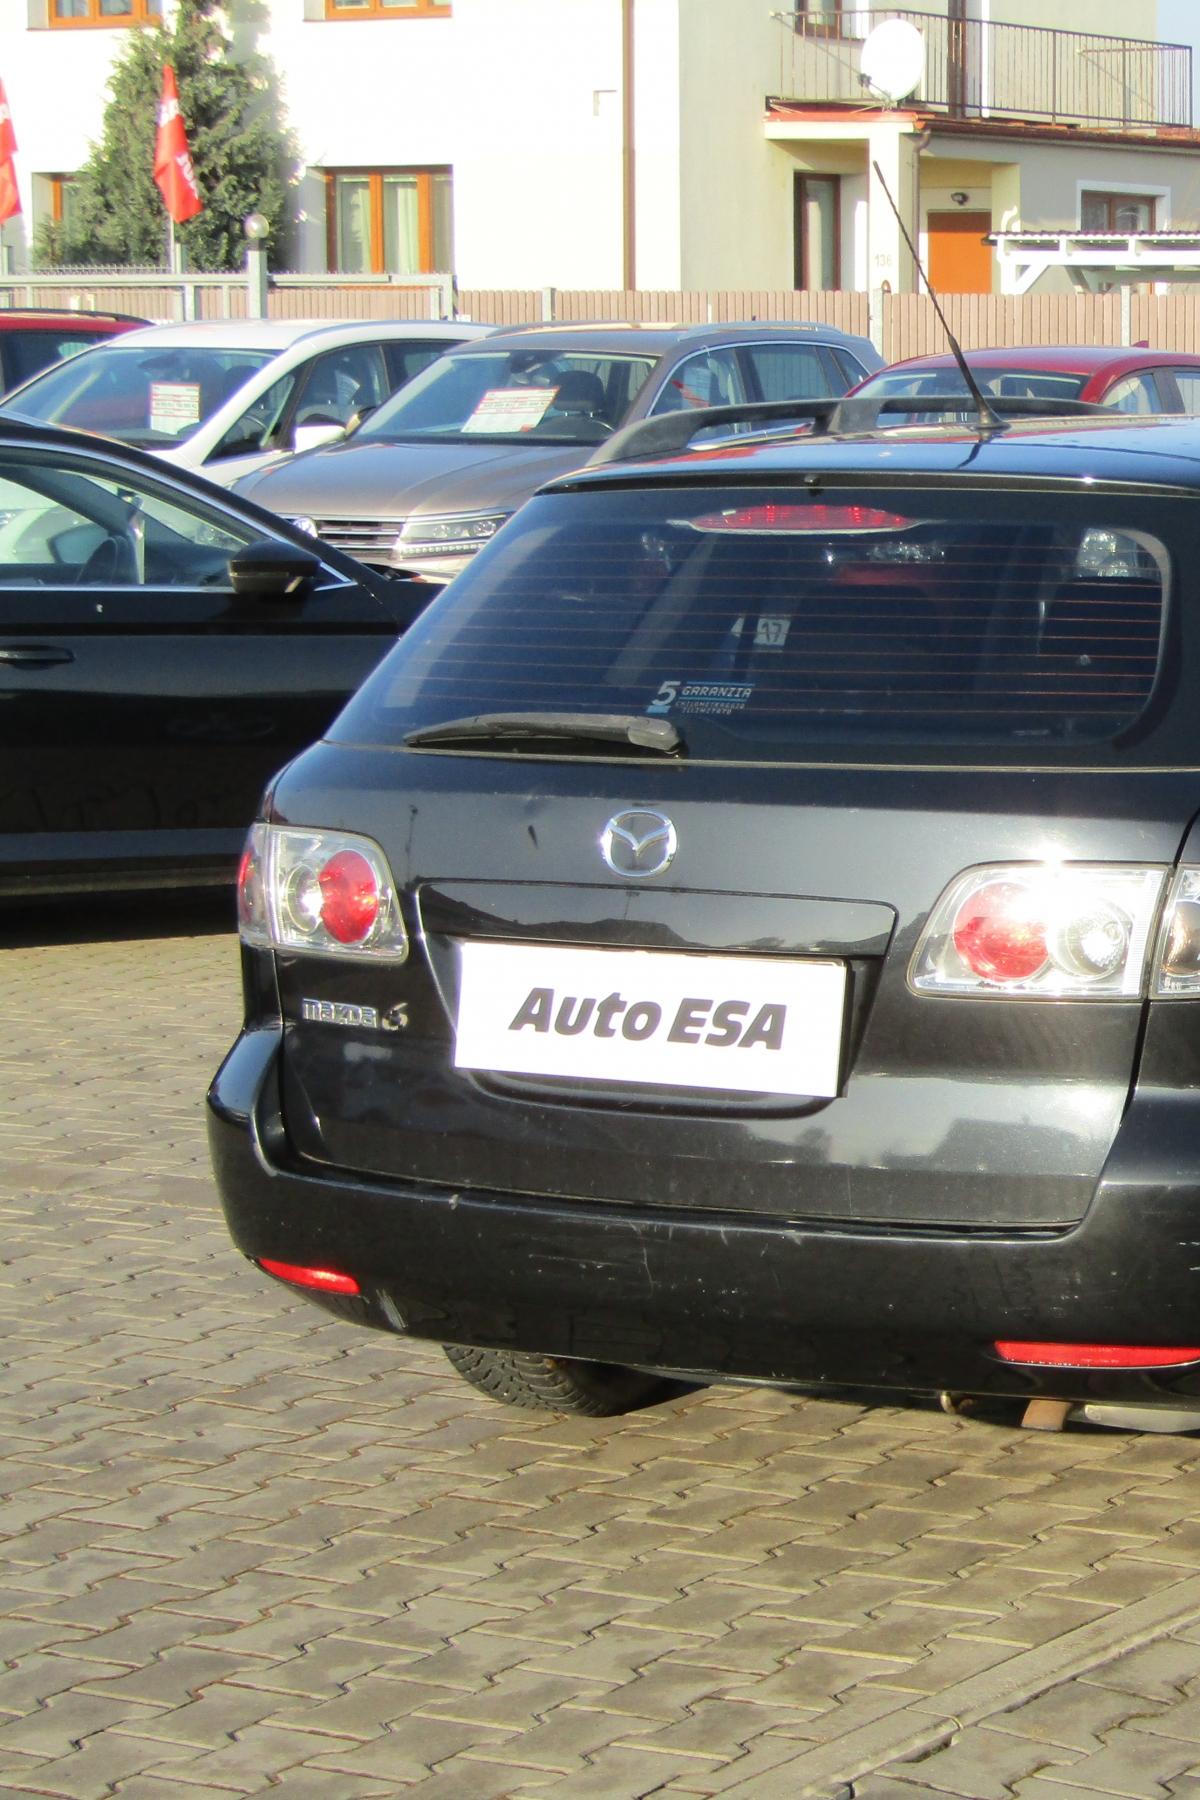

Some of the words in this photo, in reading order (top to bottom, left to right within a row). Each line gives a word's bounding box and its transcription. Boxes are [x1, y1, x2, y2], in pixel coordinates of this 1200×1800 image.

[651, 680, 681, 706] 5
[681, 686, 752, 699] GARANZIA
[381, 1002, 409, 1031] 6
[508, 987, 662, 1041] Auto
[667, 997, 787, 1050] ESA
